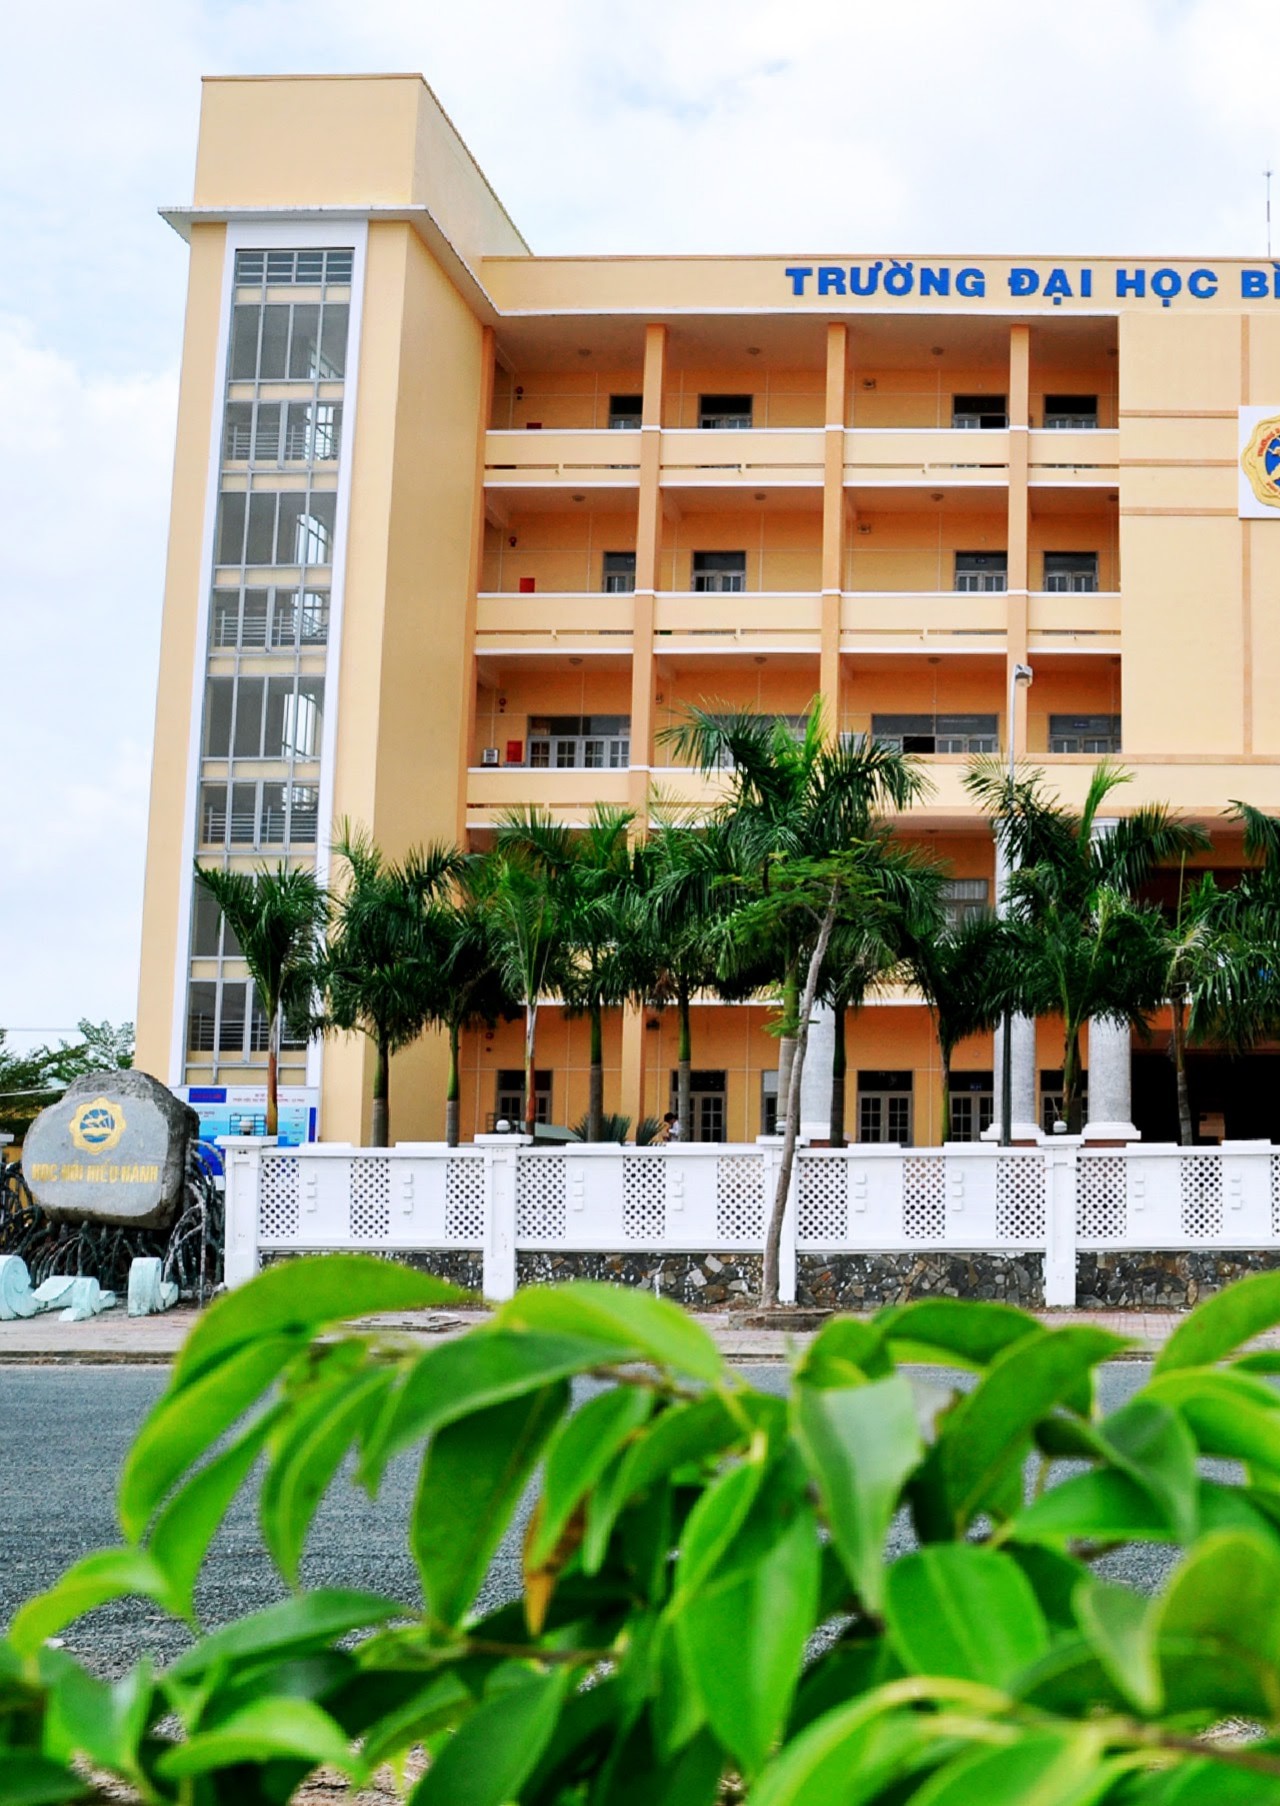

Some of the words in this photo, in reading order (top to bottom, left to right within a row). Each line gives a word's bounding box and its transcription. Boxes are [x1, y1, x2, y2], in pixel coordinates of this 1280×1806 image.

[785, 261, 985, 297] TRƯỜNG
[1008, 268, 1092, 304] ĐẠI
[1116, 269, 1217, 306] HỌC
